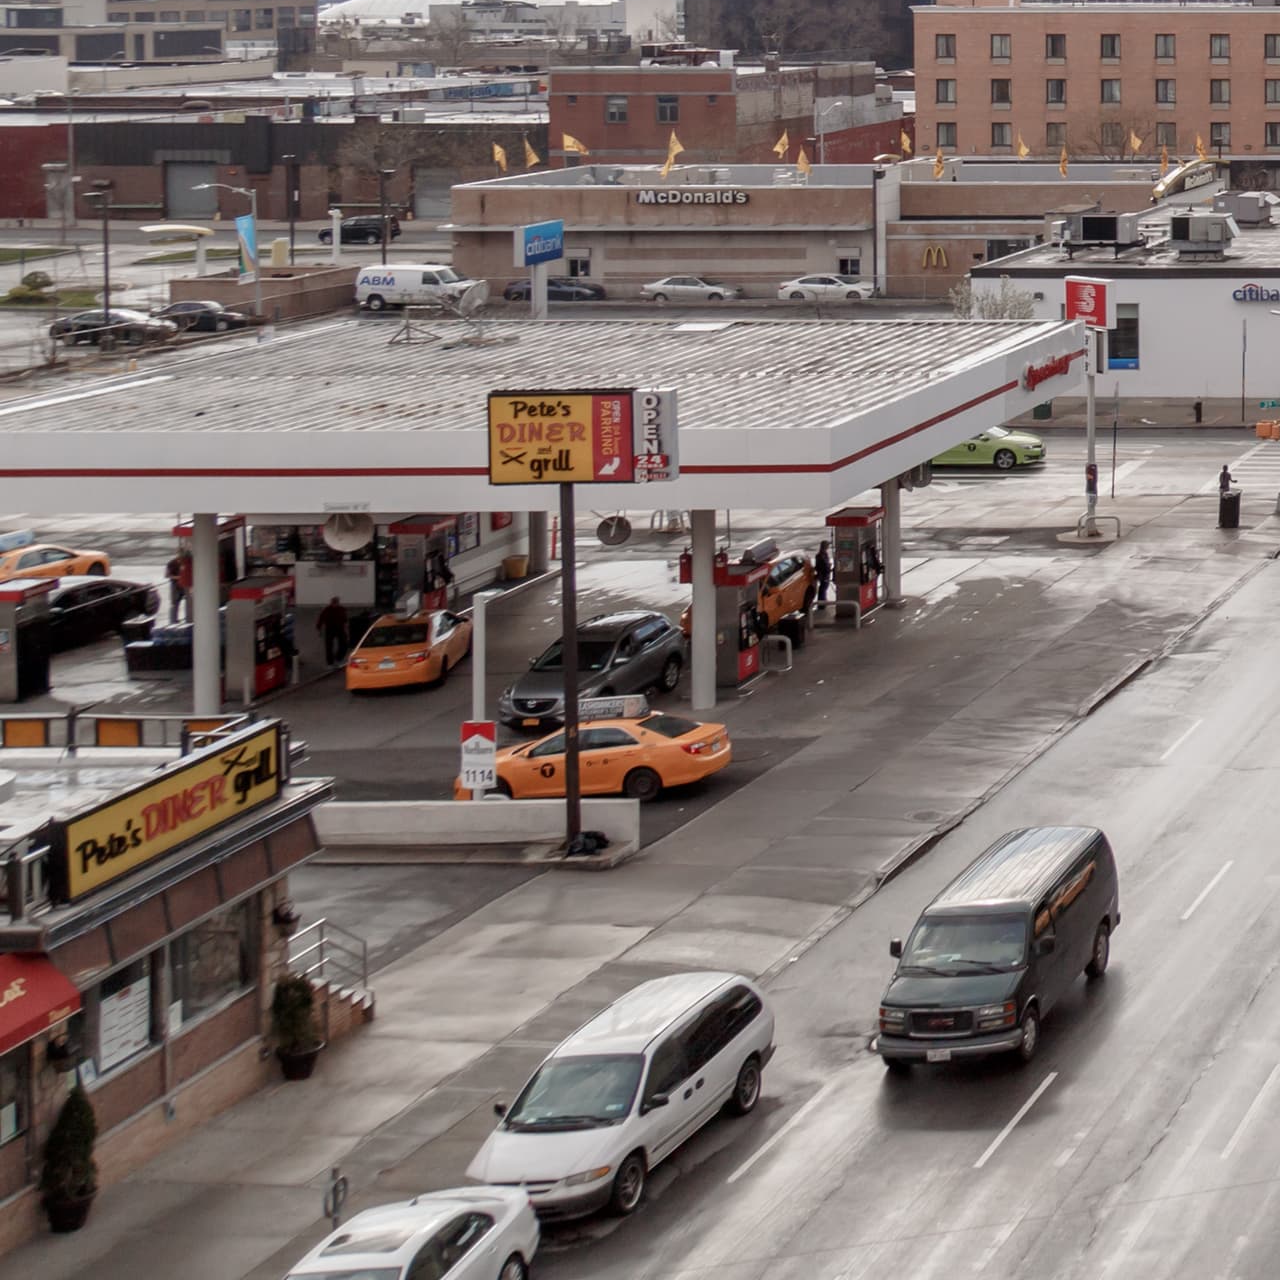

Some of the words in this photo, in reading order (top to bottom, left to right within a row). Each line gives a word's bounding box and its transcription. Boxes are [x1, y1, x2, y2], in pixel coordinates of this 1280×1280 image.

[637, 189, 748, 205] McDonald's
[526, 233, 562, 257] citibank
[359, 275, 396, 286] ABM
[508, 400, 572, 419] Pete's
[496, 421, 587, 444] DINER
[600, 401, 613, 456] PARKING
[641, 394, 660, 454] OPEN
[529, 449, 575, 480] grill
[636, 455, 663, 465] 24
[76, 819, 143, 874] Pete's
[140, 774, 229, 843] DINER
[233, 746, 279, 806] grill
